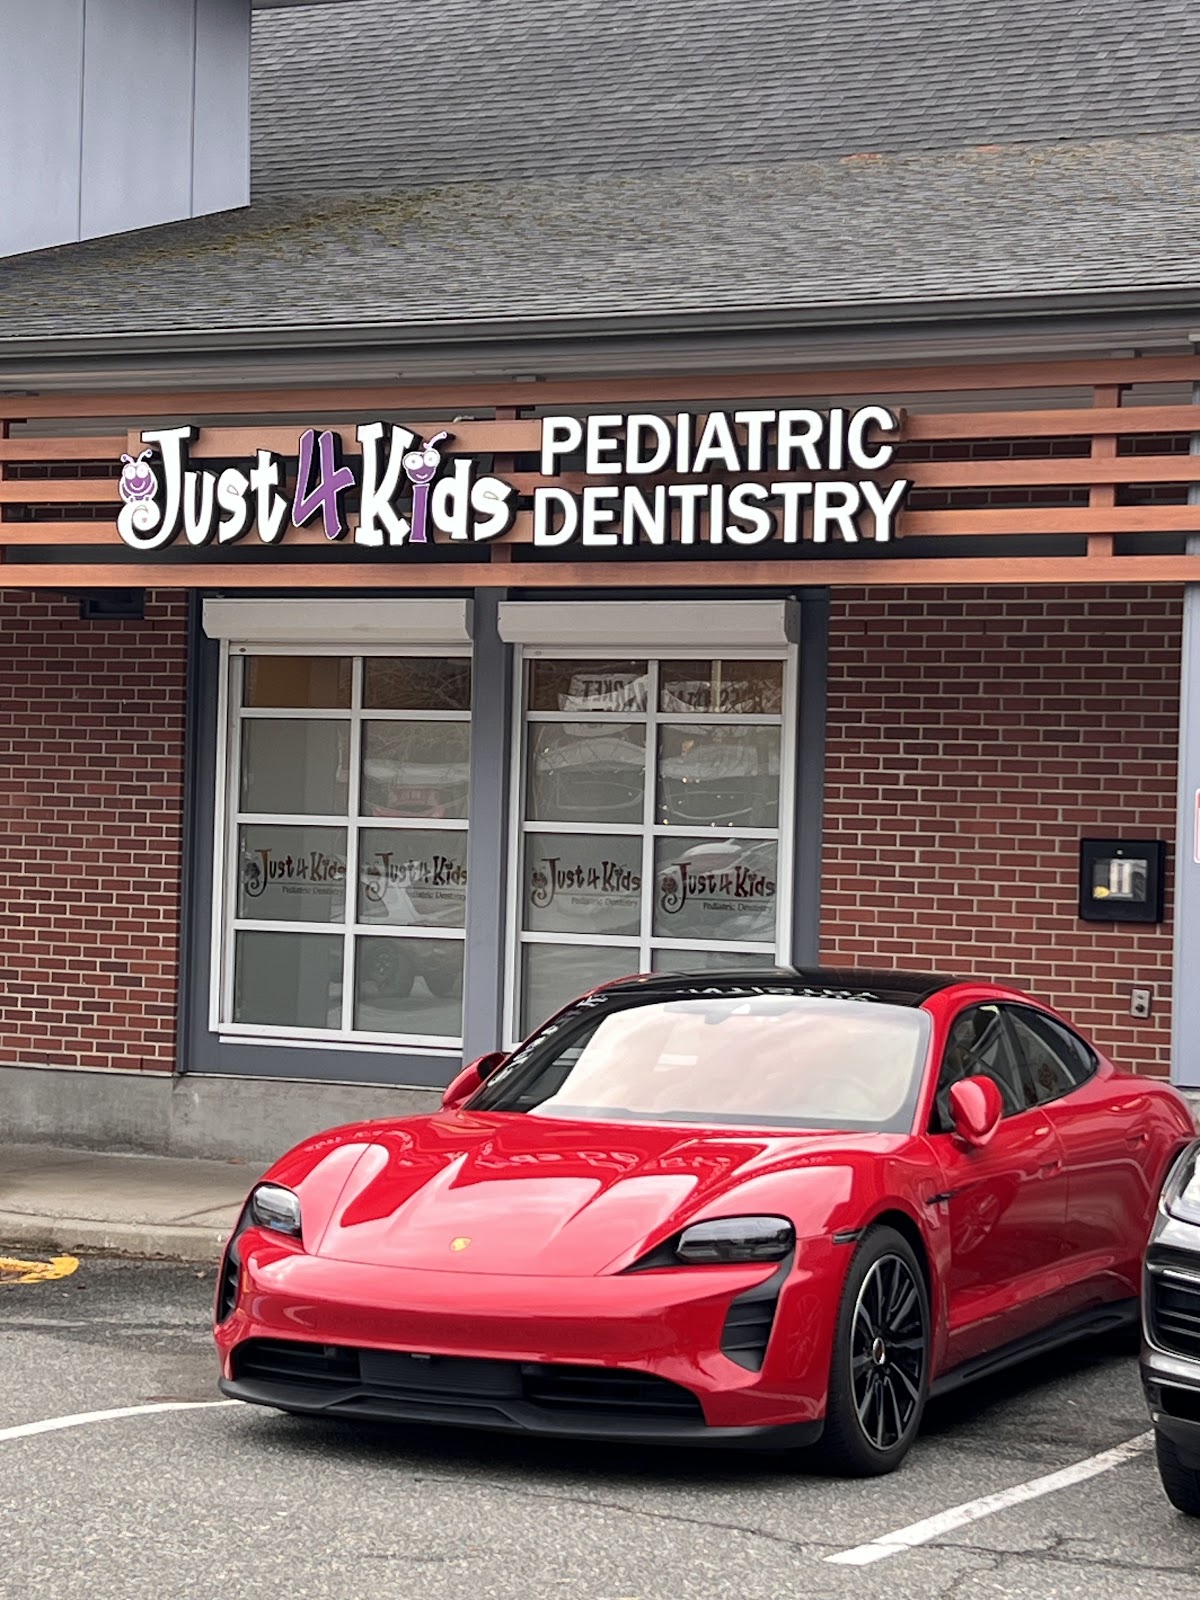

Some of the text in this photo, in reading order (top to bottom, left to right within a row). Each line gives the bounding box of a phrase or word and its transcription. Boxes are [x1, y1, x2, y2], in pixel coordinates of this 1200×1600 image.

[540, 405, 895, 476] PEDIATRIC
[117, 421, 512, 550] Just 4 Kids
[533, 479, 908, 547] DENTISTRY
[245, 849, 294, 897] Just
[310, 851, 347, 881] Kids
[432, 855, 468, 886] Kids
[531, 858, 585, 908] Just
[601, 860, 641, 892] Kids
[661, 862, 717, 914] Just
[734, 865, 776, 897] Kids
